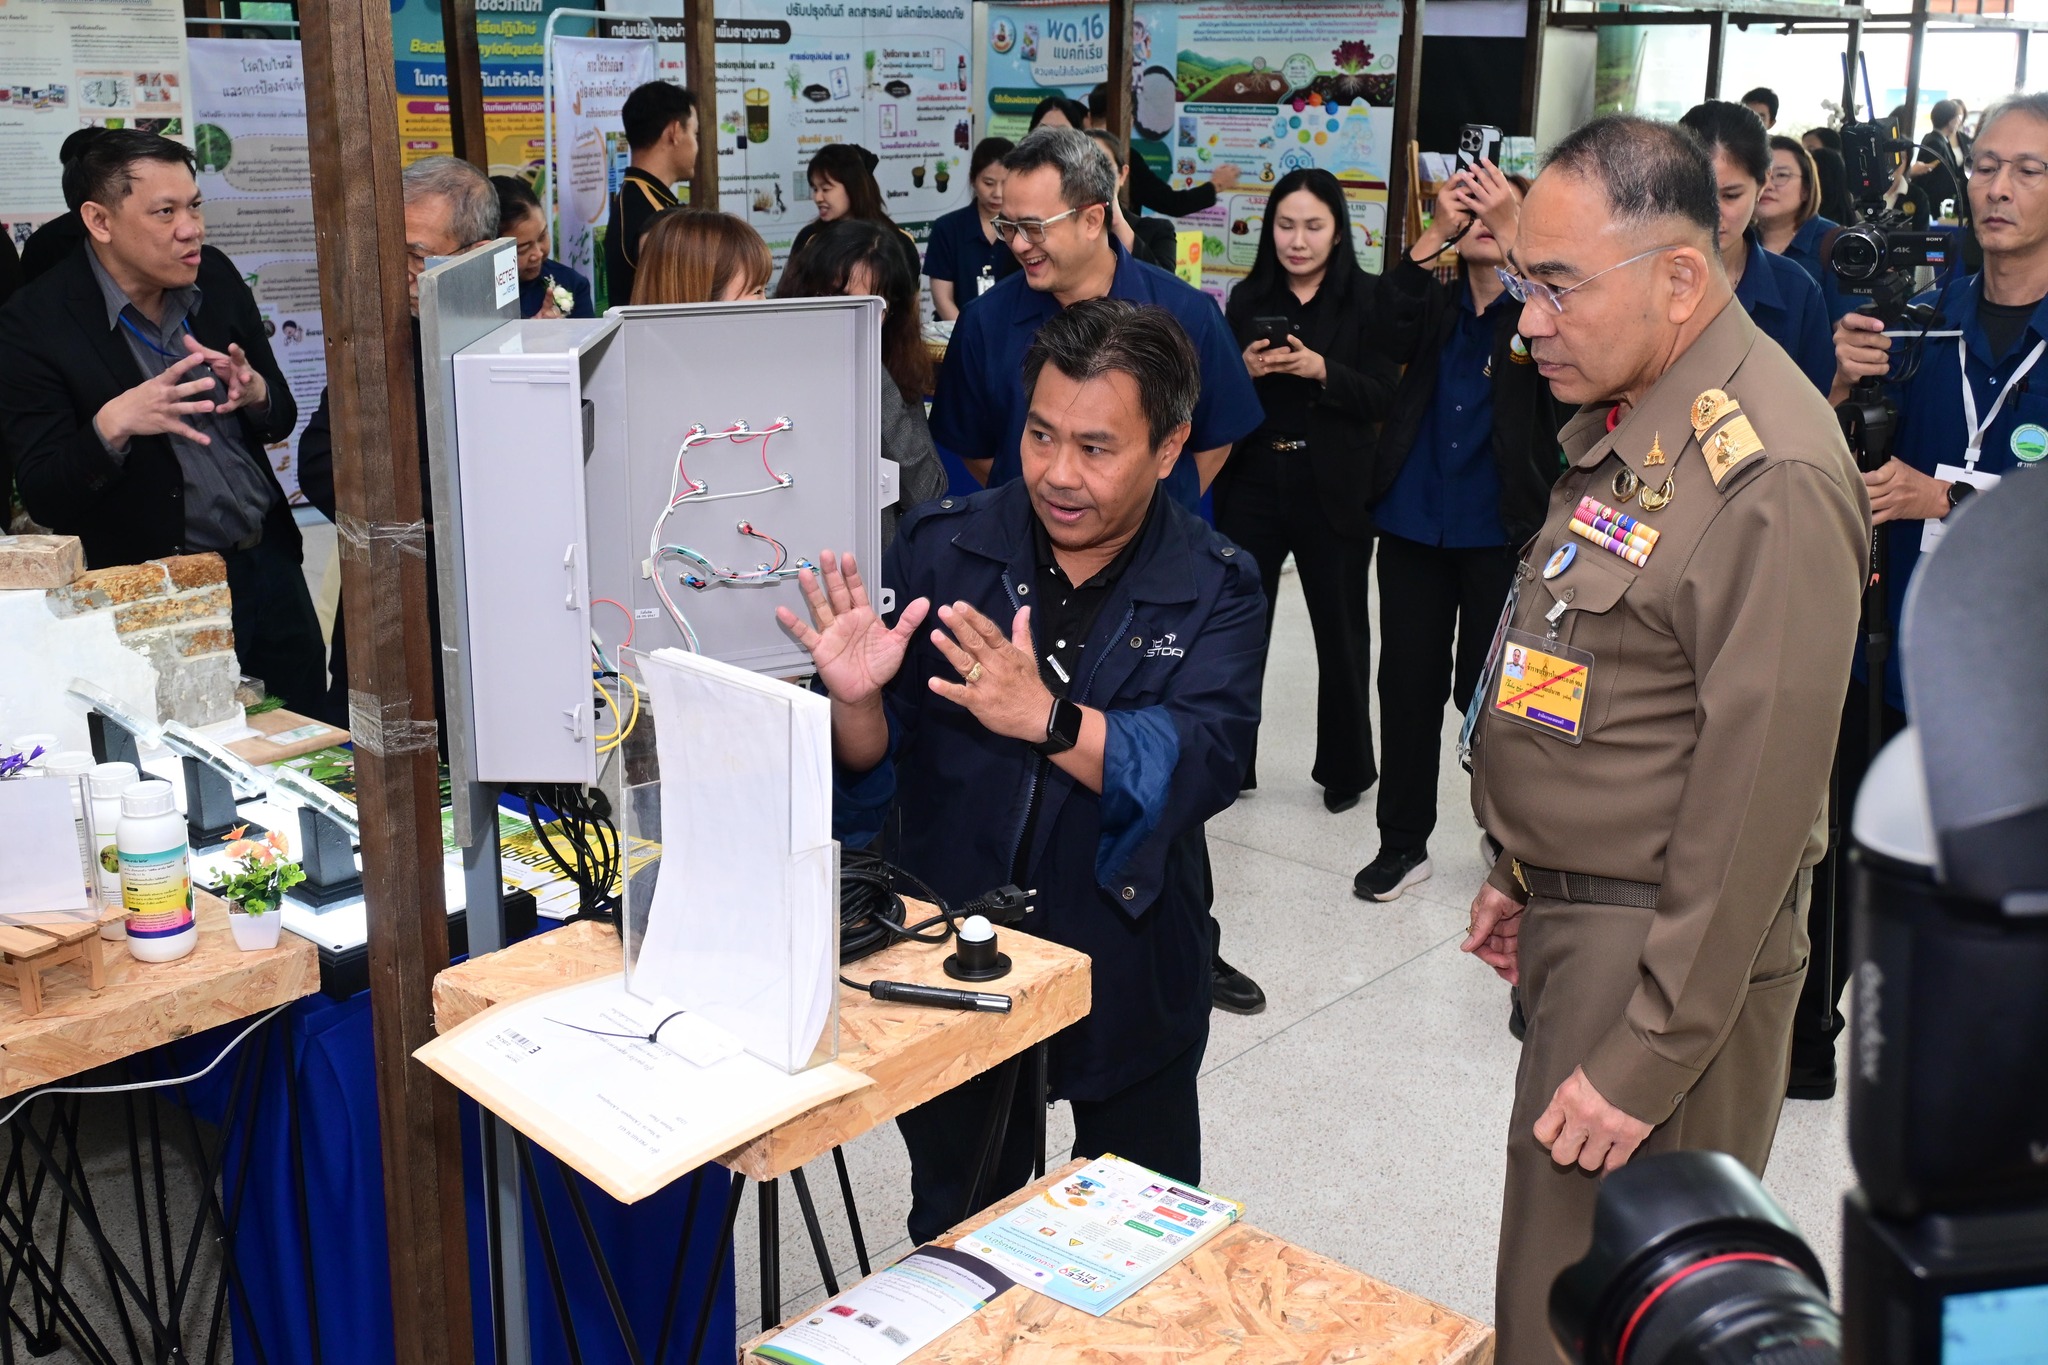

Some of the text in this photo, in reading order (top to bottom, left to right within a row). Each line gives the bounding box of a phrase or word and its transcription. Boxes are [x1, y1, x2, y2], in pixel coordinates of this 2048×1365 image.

[786, 2, 965, 21] ปรับปรุงดินดี ลดสารเคมี ผลิตพืชปลอดภัย
[716, 20, 780, 42] เพิ่มธาตุอาหาร
[1047, 13, 1105, 43] พด.16
[1053, 43, 1103, 61] แบคทีเรีย
[1034, 64, 1108, 79] ควบคุมไส้เดือนฝอยรา
[223, 77, 304, 97] และการป้องกันกำ
[1065, 1271, 1091, 1284] RICE
[1078, 1271, 1098, 1280] FIT
